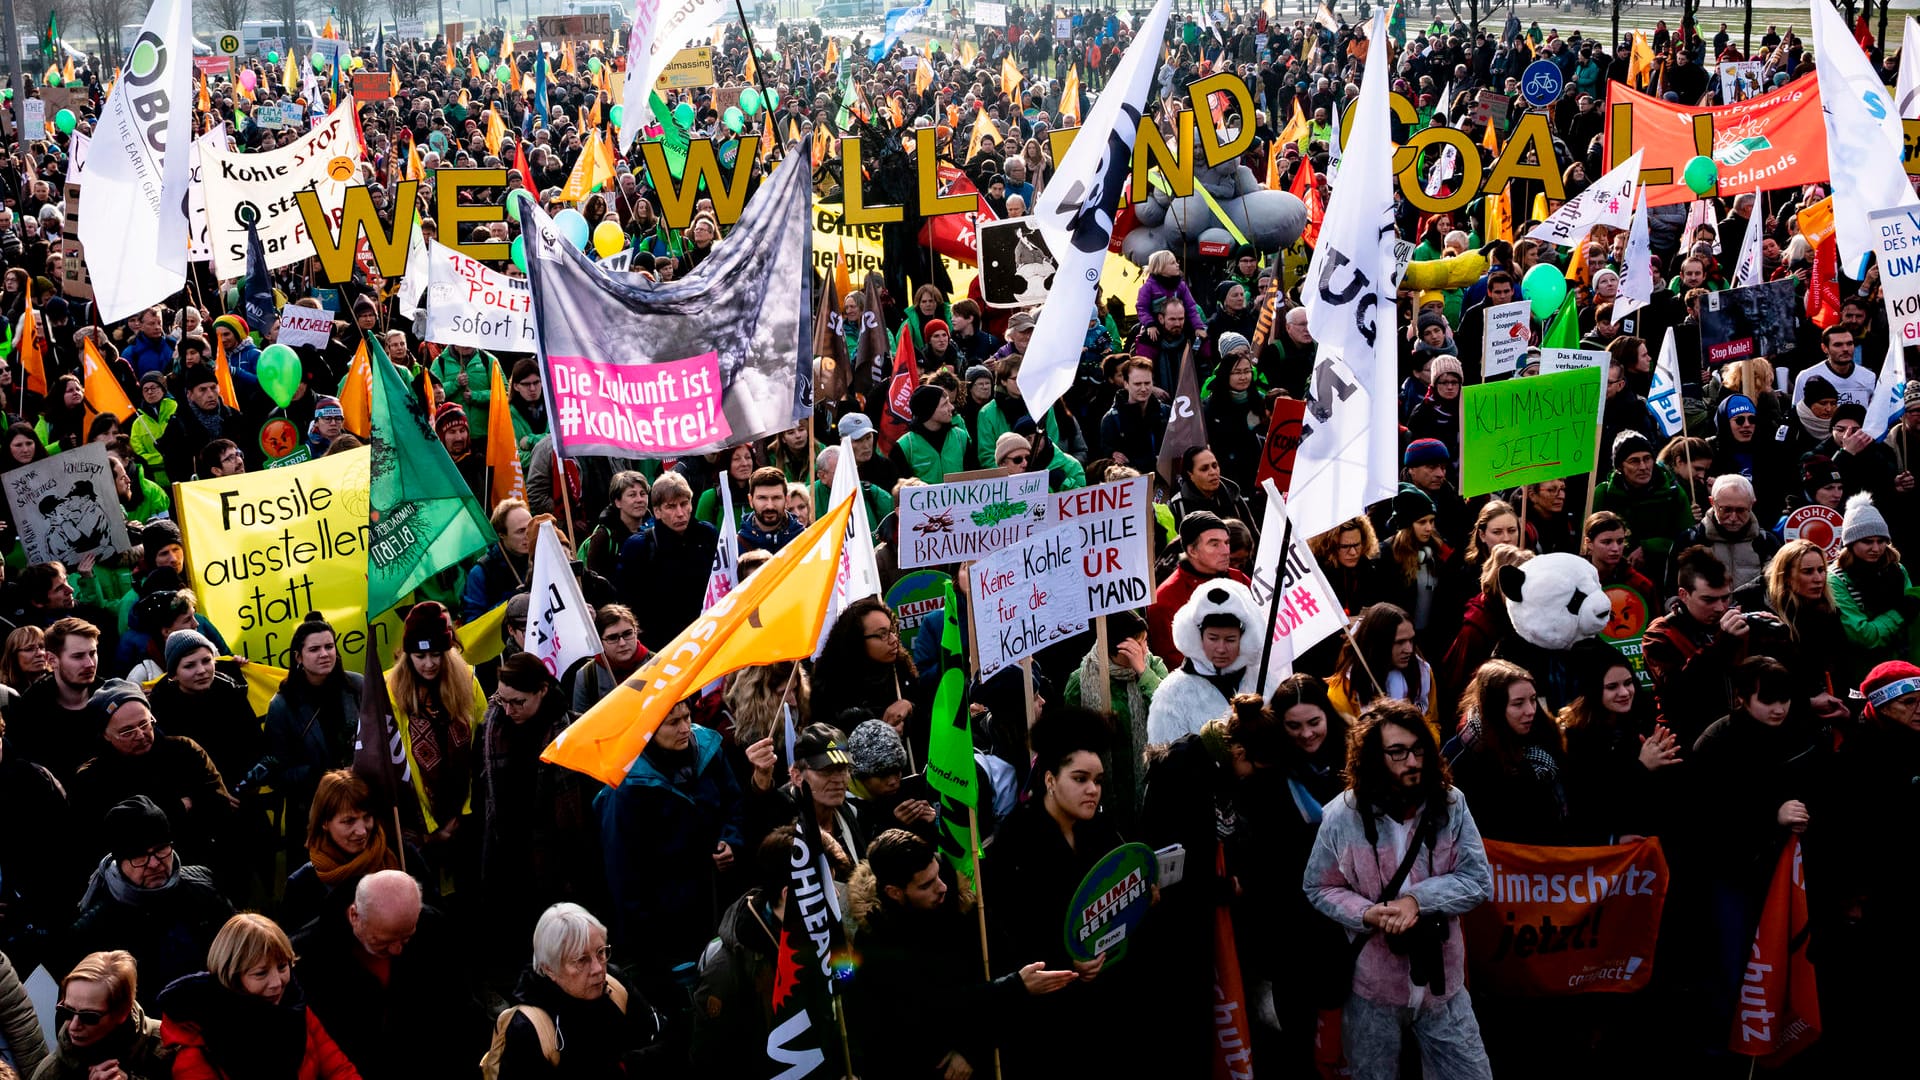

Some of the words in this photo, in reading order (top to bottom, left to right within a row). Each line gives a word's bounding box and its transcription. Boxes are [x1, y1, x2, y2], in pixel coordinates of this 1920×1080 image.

[118, 120, 131, 142] THE
[125, 142, 148, 179] EARTH
[221, 160, 288, 182] Kohle
[230, 233, 288, 260] Slar
[1881, 222, 1904, 237] DIE
[1883, 236, 1908, 252] DES
[450, 311, 512, 338] sofort
[1557, 352, 1570, 360] Das
[1572, 353, 1593, 361] Klima
[1711, 347, 1728, 360] Stop
[1727, 341, 1751, 355] Kohle!
[554, 363, 592, 397] Die
[594, 369, 678, 406] Zukunft
[681, 365, 713, 399] ist
[559, 396, 719, 447] #kohlefrei!
[1473, 381, 1601, 434] KLIMASCHUTZ
[1730, 405, 1750, 414] NABU
[219, 477, 333, 531] Fossile
[909, 480, 1014, 511] GRÜNKOHL
[1058, 481, 1135, 522] KEINE
[1795, 508, 1836, 523] KOHLE
[980, 567, 1015, 601] Keine
[1022, 535, 1073, 580] Kohle
[1083, 547, 1123, 579] ÜR
[237, 573, 314, 632] statt
[997, 597, 1018, 624] für
[1028, 582, 1048, 612] die
[1088, 576, 1148, 612] MAND
[999, 613, 1048, 663] Kohle
[927, 760, 970, 789] bund.net
[1079, 879, 1147, 942] RETTEN!
[1085, 871, 1140, 922] KLIMA
[1490, 904, 1605, 962] jetzt!
